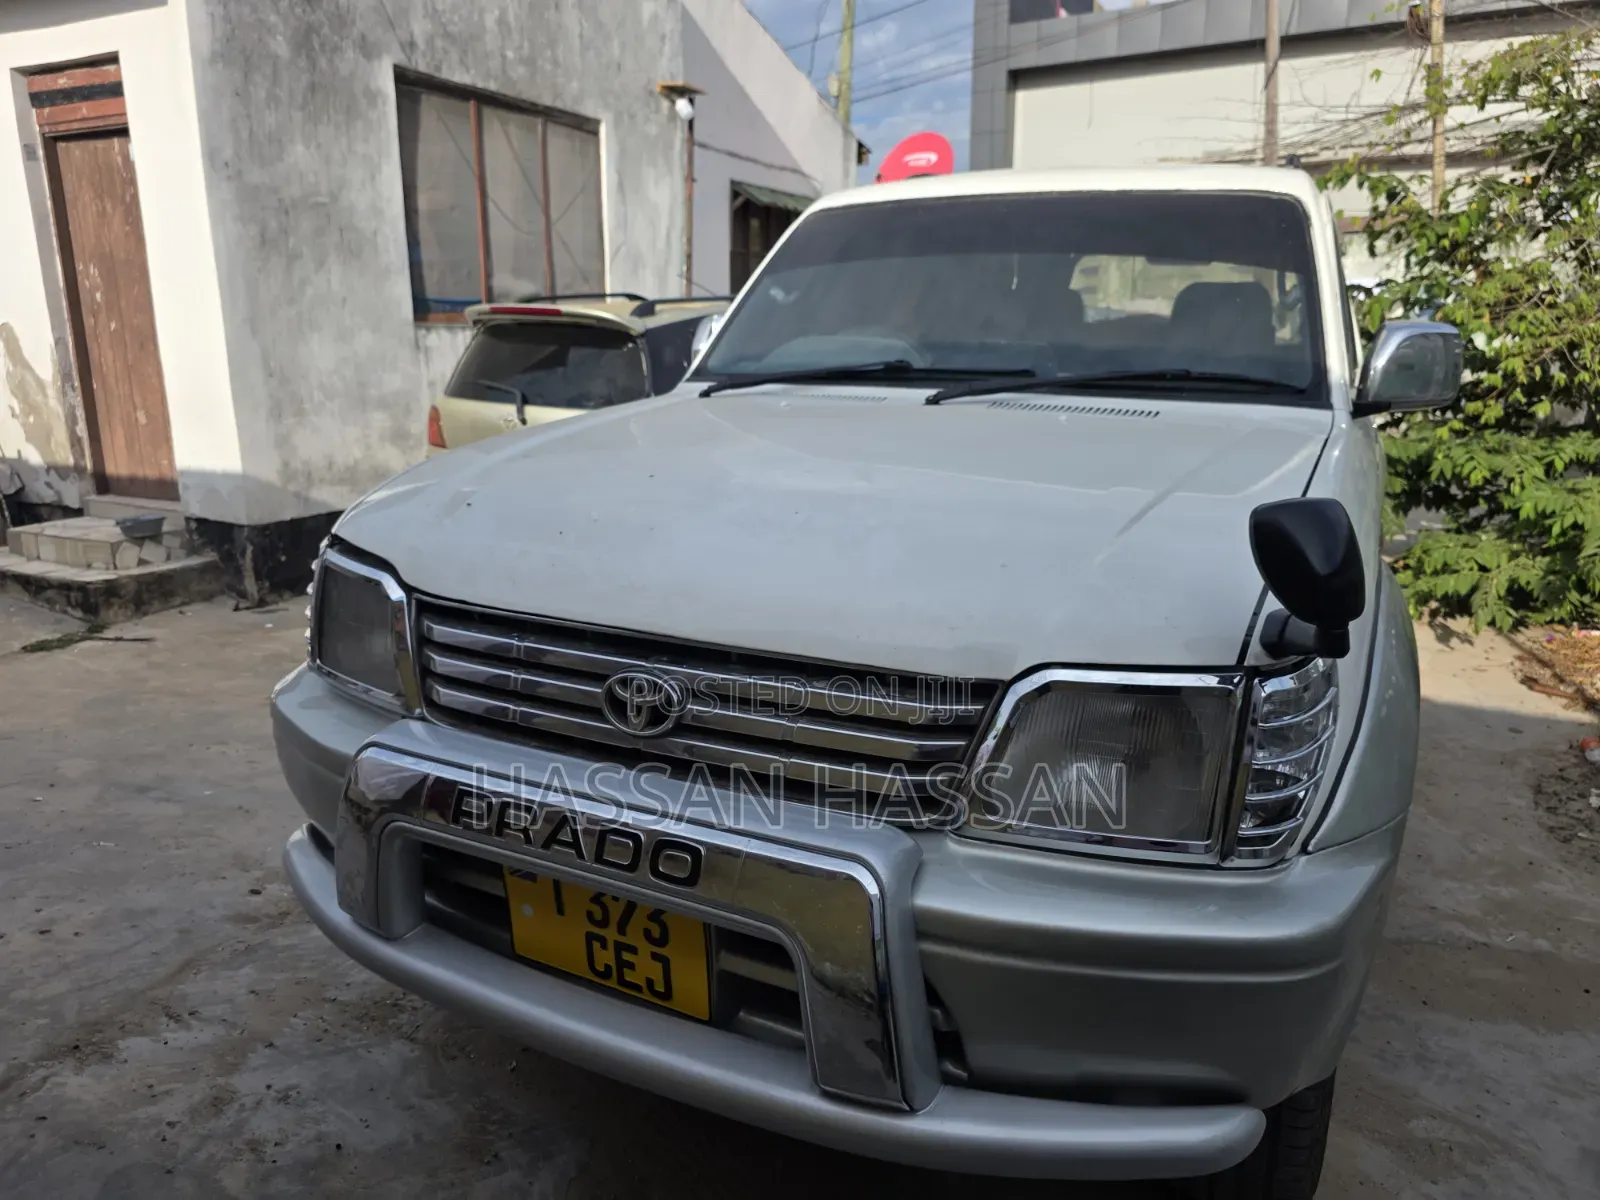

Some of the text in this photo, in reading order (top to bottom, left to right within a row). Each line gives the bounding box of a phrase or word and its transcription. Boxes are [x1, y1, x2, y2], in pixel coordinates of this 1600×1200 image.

[450, 785, 706, 890] PRADO
[585, 891, 670, 948] 373
[584, 930, 674, 1001] CEJ
